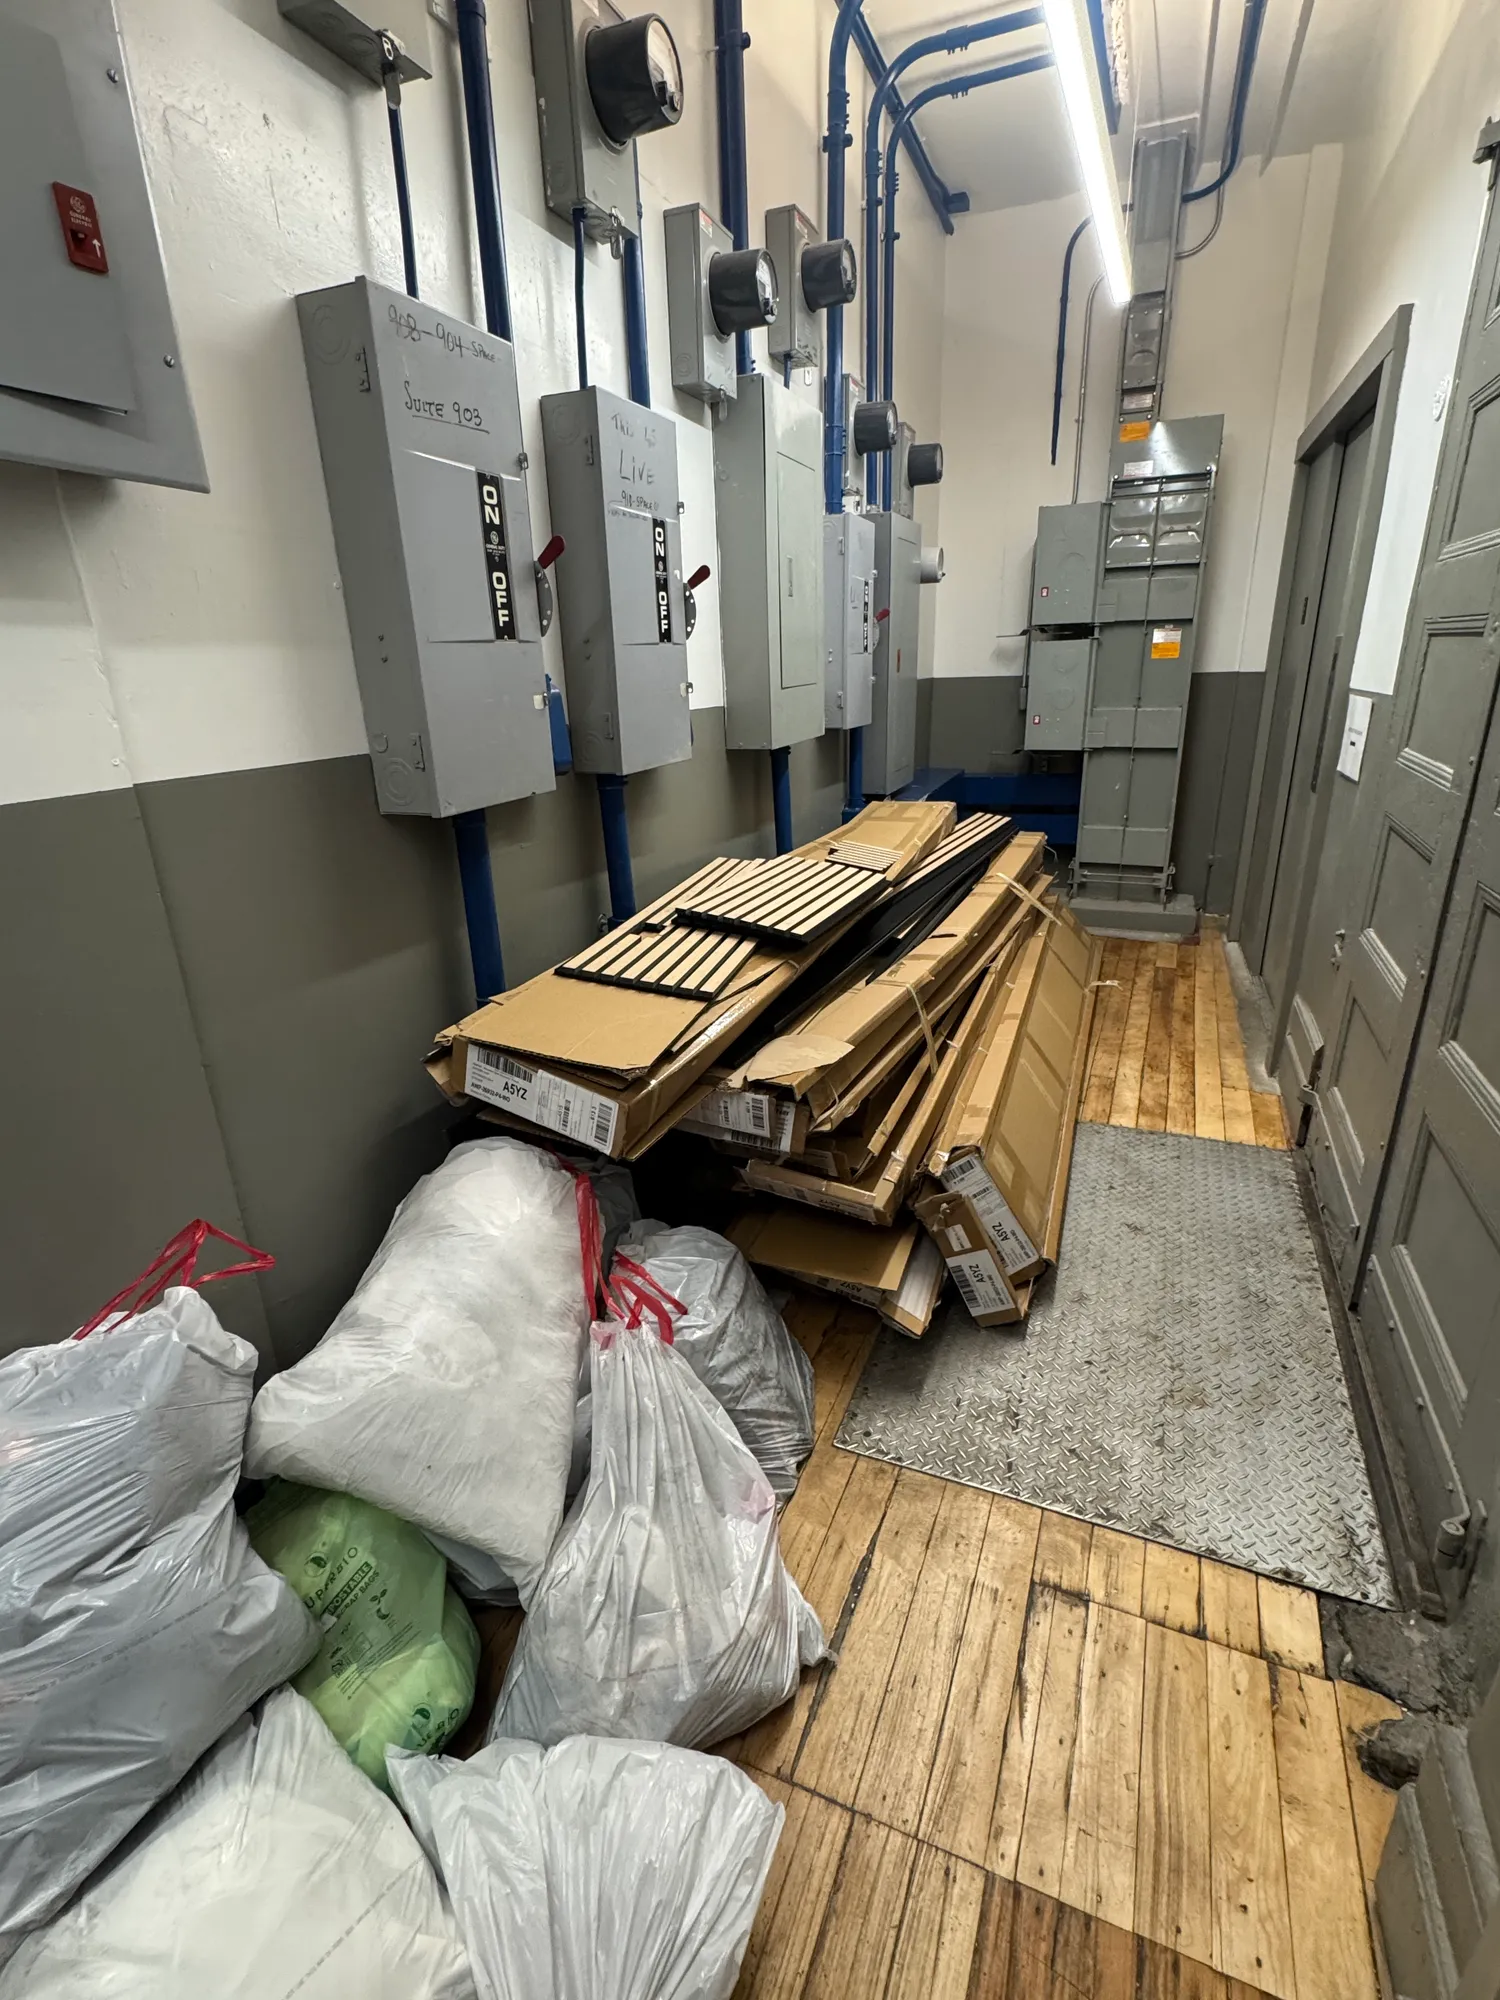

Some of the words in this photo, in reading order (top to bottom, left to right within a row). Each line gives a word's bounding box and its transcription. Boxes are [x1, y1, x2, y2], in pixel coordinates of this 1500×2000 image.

[452, 402, 482, 426] 903
[483, 485, 500, 525] ON
[655, 527, 665, 557] ON
[492, 571, 510, 627] OFF
[658, 591, 669, 633] OFF
[502, 1080, 528, 1101] A5YZ
[991, 1221, 1011, 1242] A5YZ
[968, 1263, 986, 1284] A5YZ
[327, 1562, 372, 1615] POSTABLE
[359, 1570, 380, 1594] BAGS
